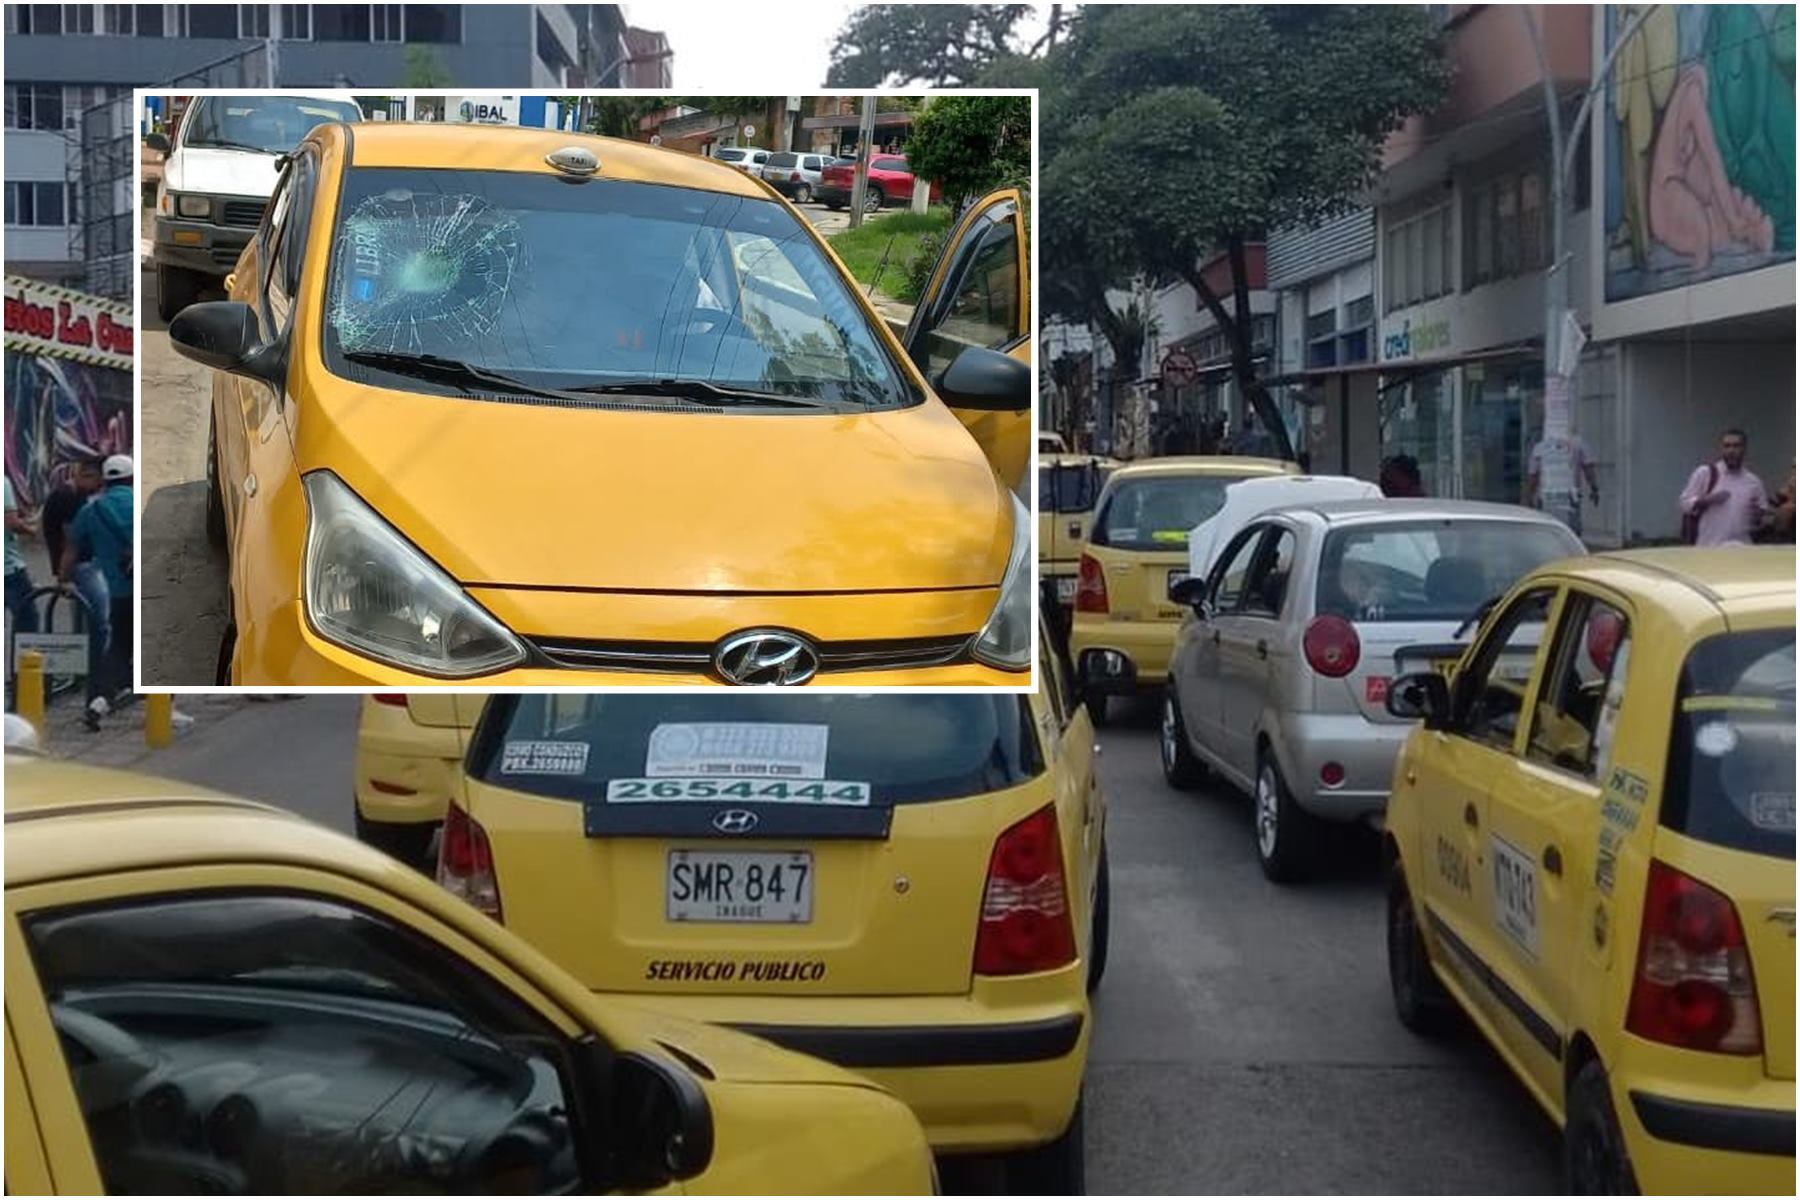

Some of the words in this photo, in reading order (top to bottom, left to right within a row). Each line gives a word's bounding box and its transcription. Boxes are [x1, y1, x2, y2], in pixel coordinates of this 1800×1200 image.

[475, 104, 508, 121] IBAL
[614, 781, 866, 801] 2654444
[672, 863, 734, 901] SMR
[745, 863, 808, 903] 847
[645, 960, 736, 982] SERVICIO
[740, 960, 827, 982] PUBLICO
